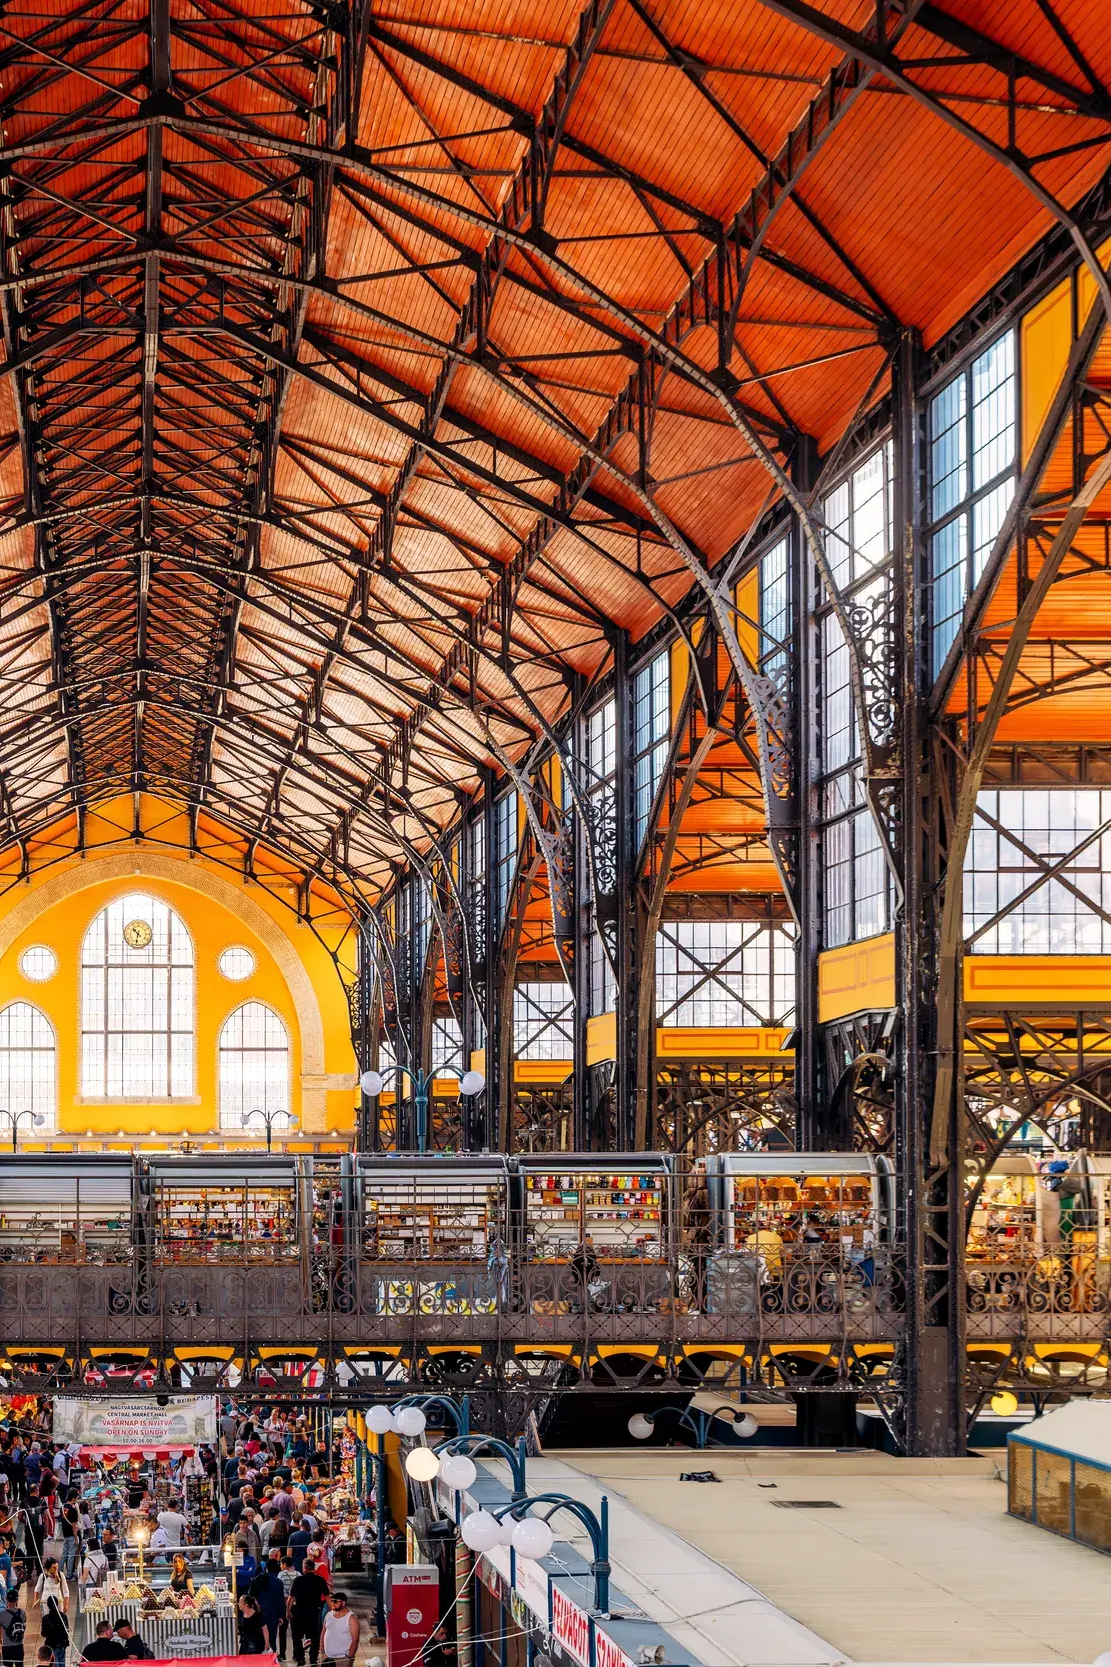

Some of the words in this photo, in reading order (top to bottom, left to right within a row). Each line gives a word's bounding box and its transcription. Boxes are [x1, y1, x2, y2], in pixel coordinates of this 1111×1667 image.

[177, 1394, 214, 1404] BUDAPEST
[102, 1418, 139, 1426] VASÁRNAP
[402, 1575, 422, 1583] ATM
